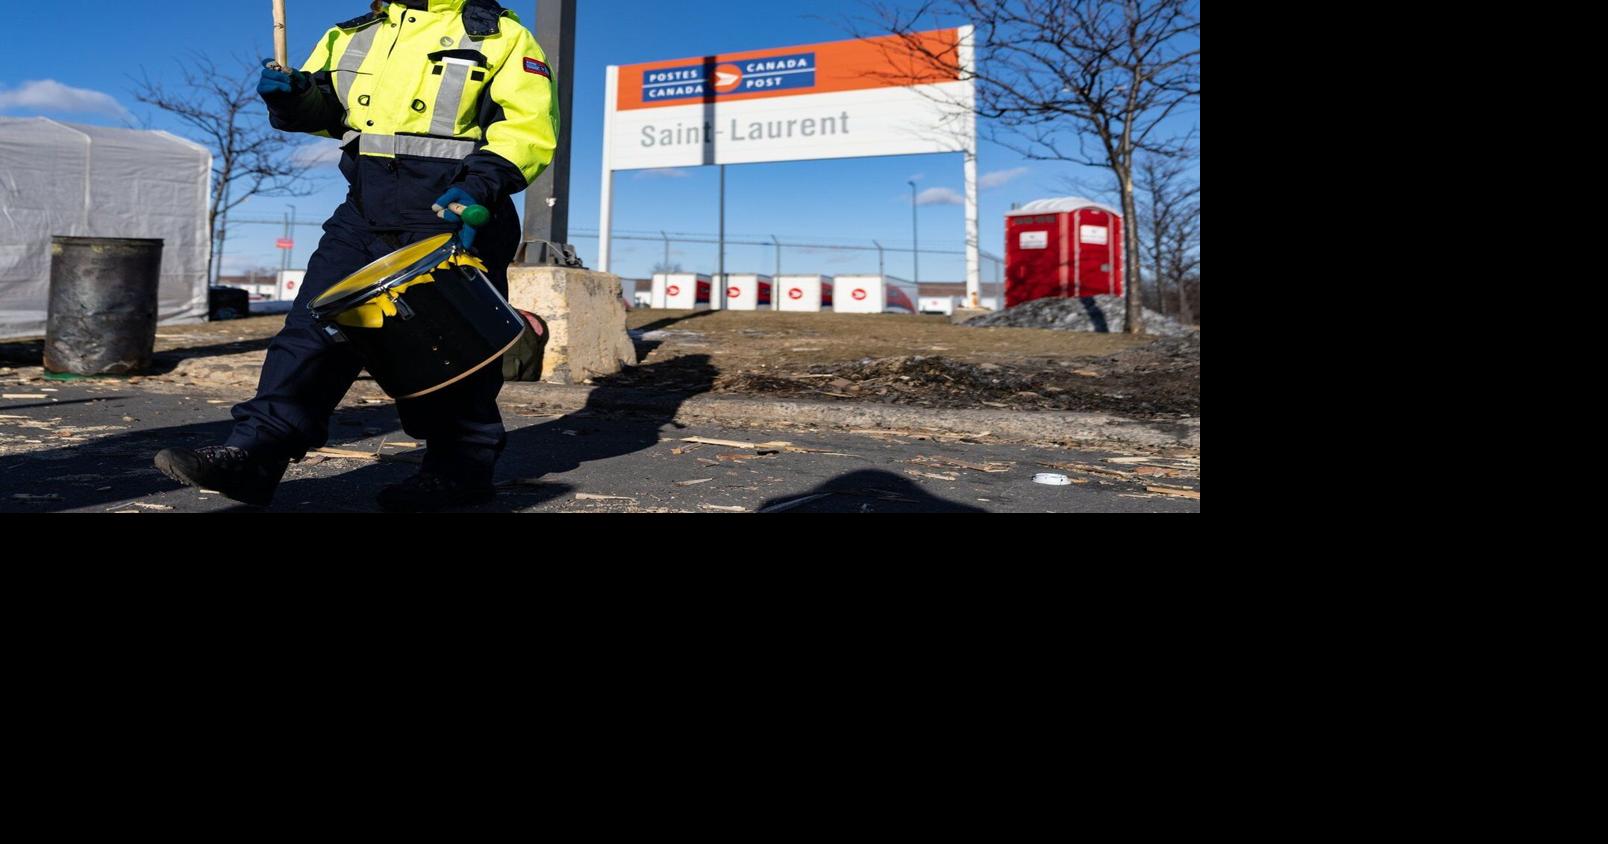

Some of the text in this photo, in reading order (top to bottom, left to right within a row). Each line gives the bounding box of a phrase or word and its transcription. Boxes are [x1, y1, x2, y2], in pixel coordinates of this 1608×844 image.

[746, 58, 807, 73] CANADA
[649, 69, 698, 82] POSTES
[746, 77, 782, 89] POST
[648, 84, 704, 98] CANADA
[641, 111, 849, 148] Saint-Laurent
